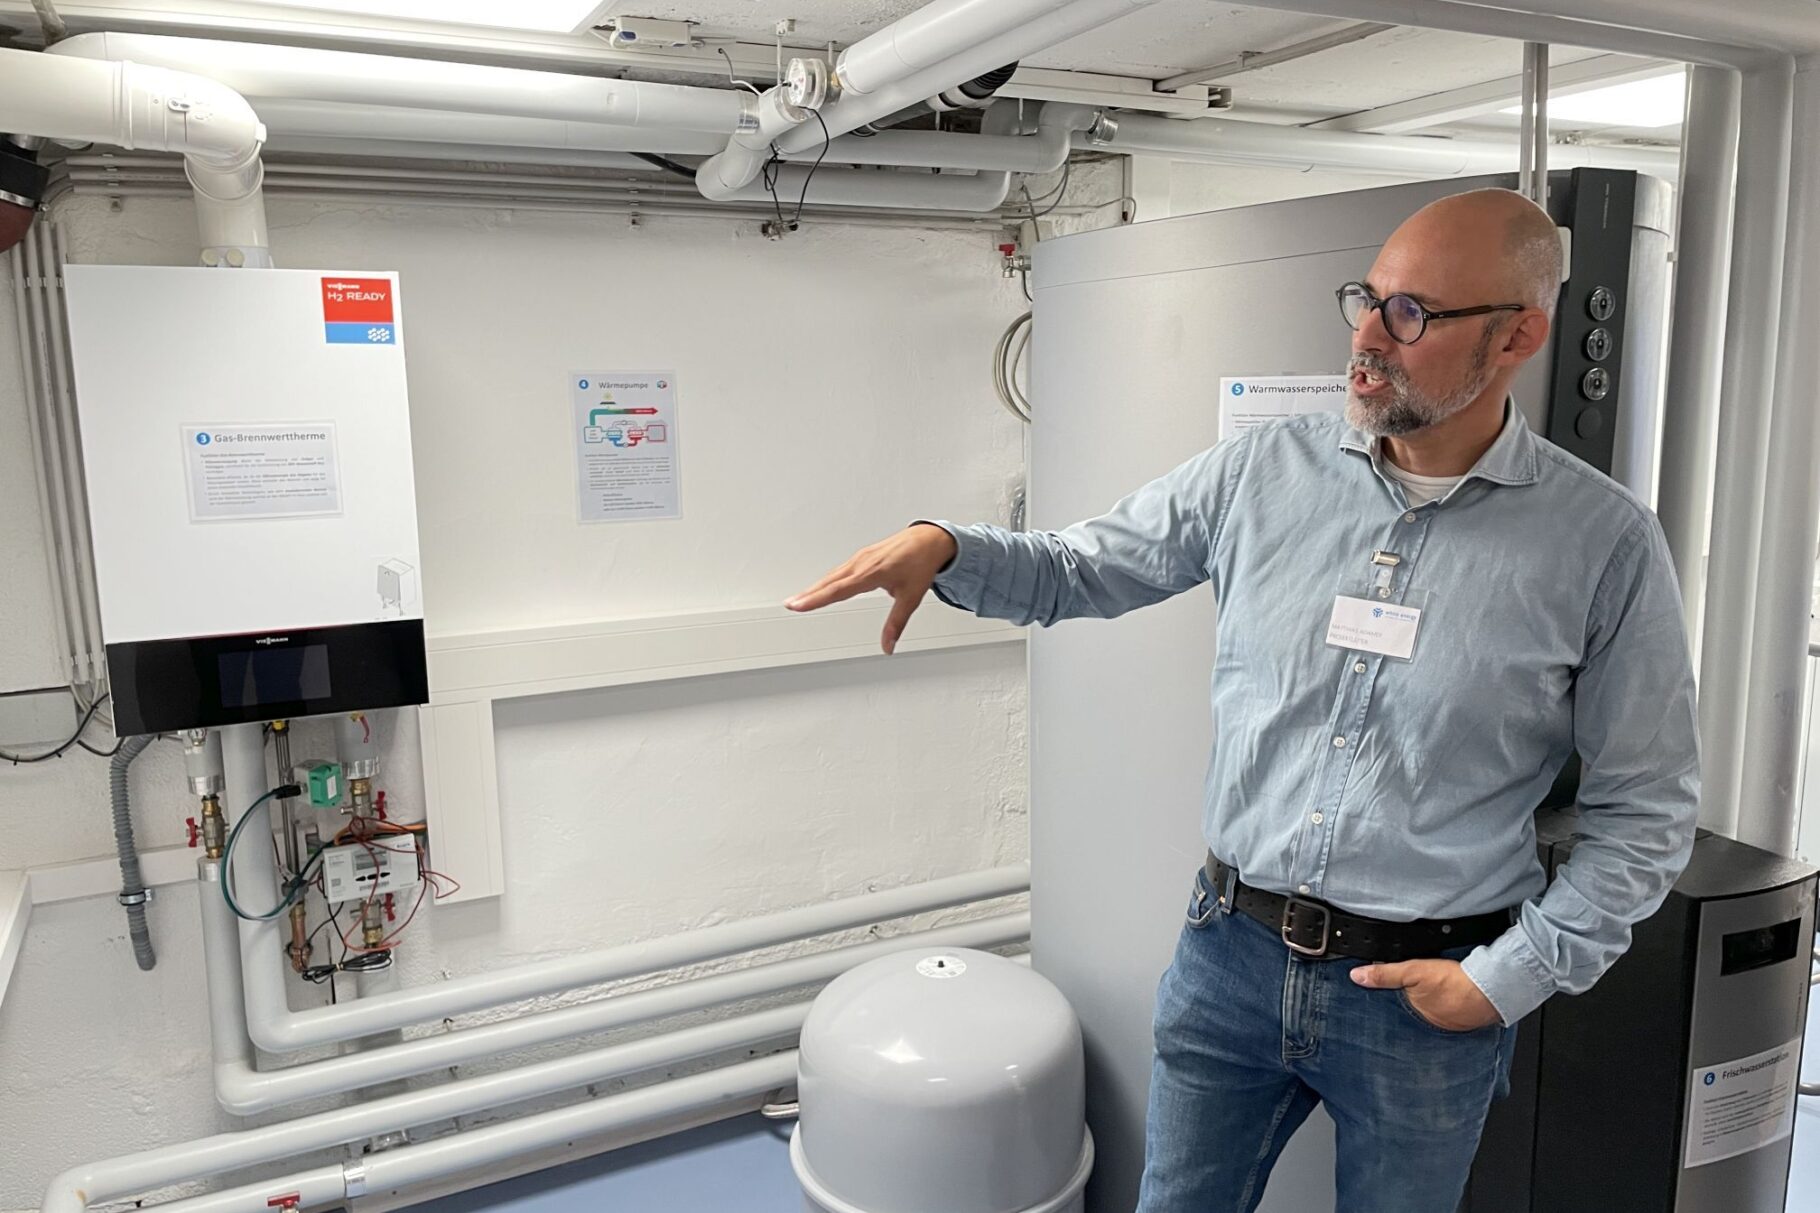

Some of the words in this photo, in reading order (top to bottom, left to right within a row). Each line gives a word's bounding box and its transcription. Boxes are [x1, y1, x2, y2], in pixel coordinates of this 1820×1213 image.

[346, 292, 386, 301] READY
[599, 381, 648, 391] Wärmepumpe
[1249, 384, 1346, 395] Warmwasserspeiche
[214, 432, 326, 443] Gas-Brennwerttherme
